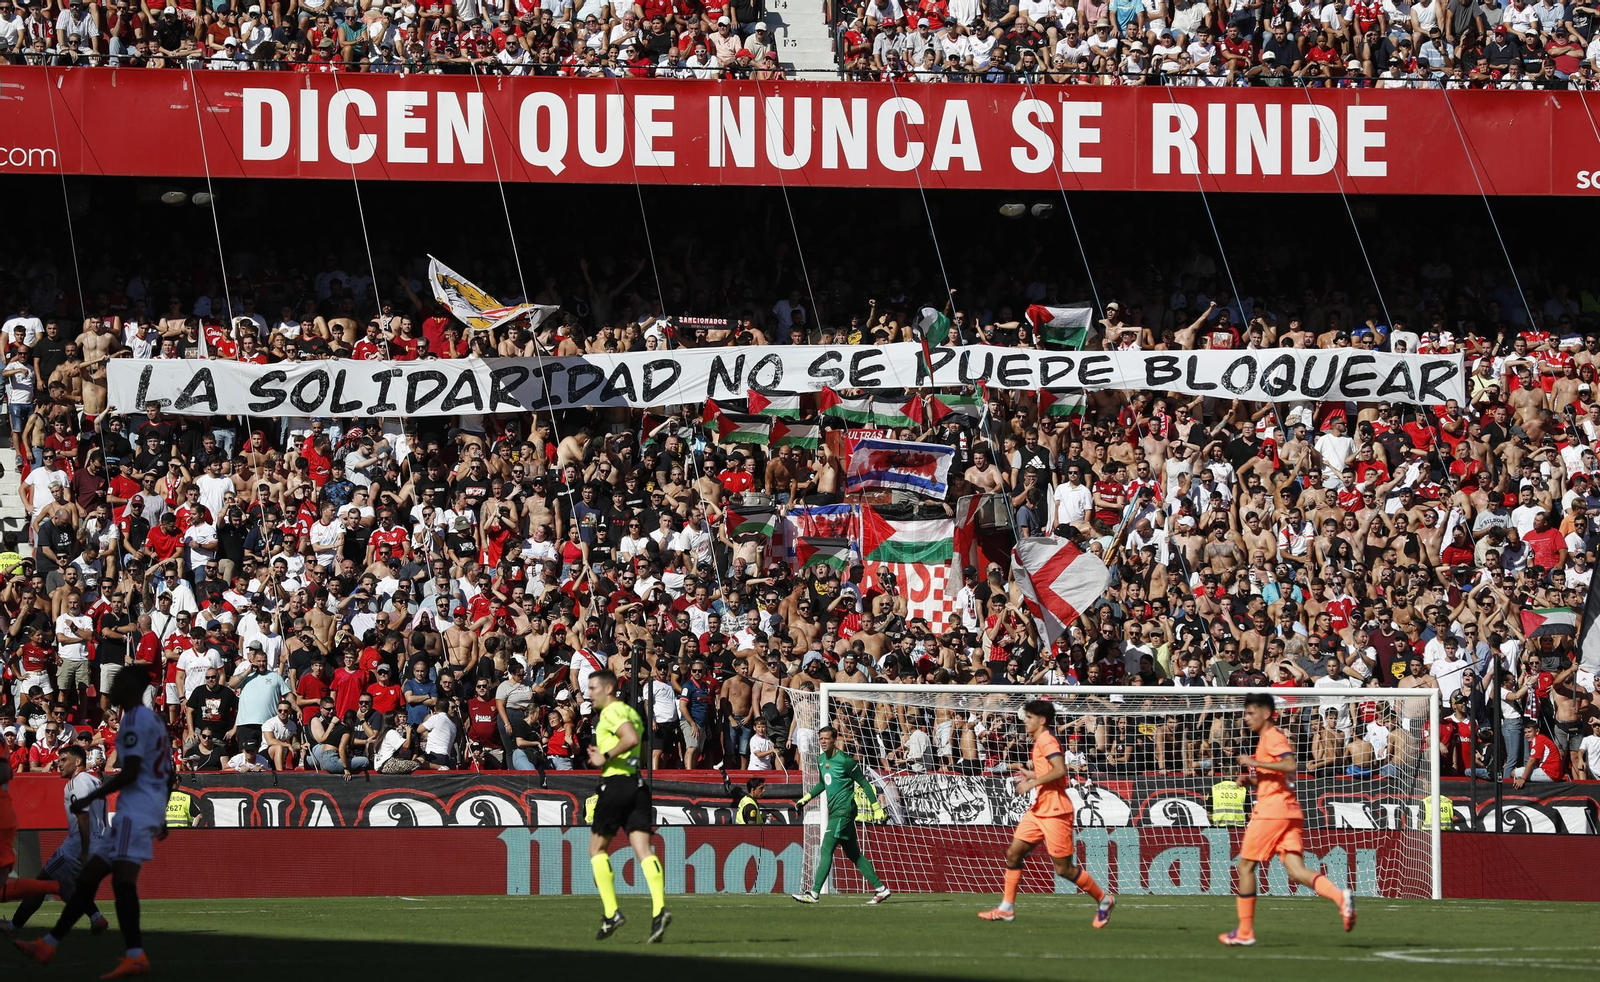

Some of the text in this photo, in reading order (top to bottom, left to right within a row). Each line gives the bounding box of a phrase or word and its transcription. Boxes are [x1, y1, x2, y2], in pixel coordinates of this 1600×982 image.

[242, 87, 1388, 177] DICEN QUE NUNCA SE RINDE
[678, 316, 728, 325] SANCIONADOS
[136, 347, 1459, 416] LA SOLIDARIDAD NO SE PUEDE BLOQUEAR
[848, 430, 884, 440] ULTRAS
